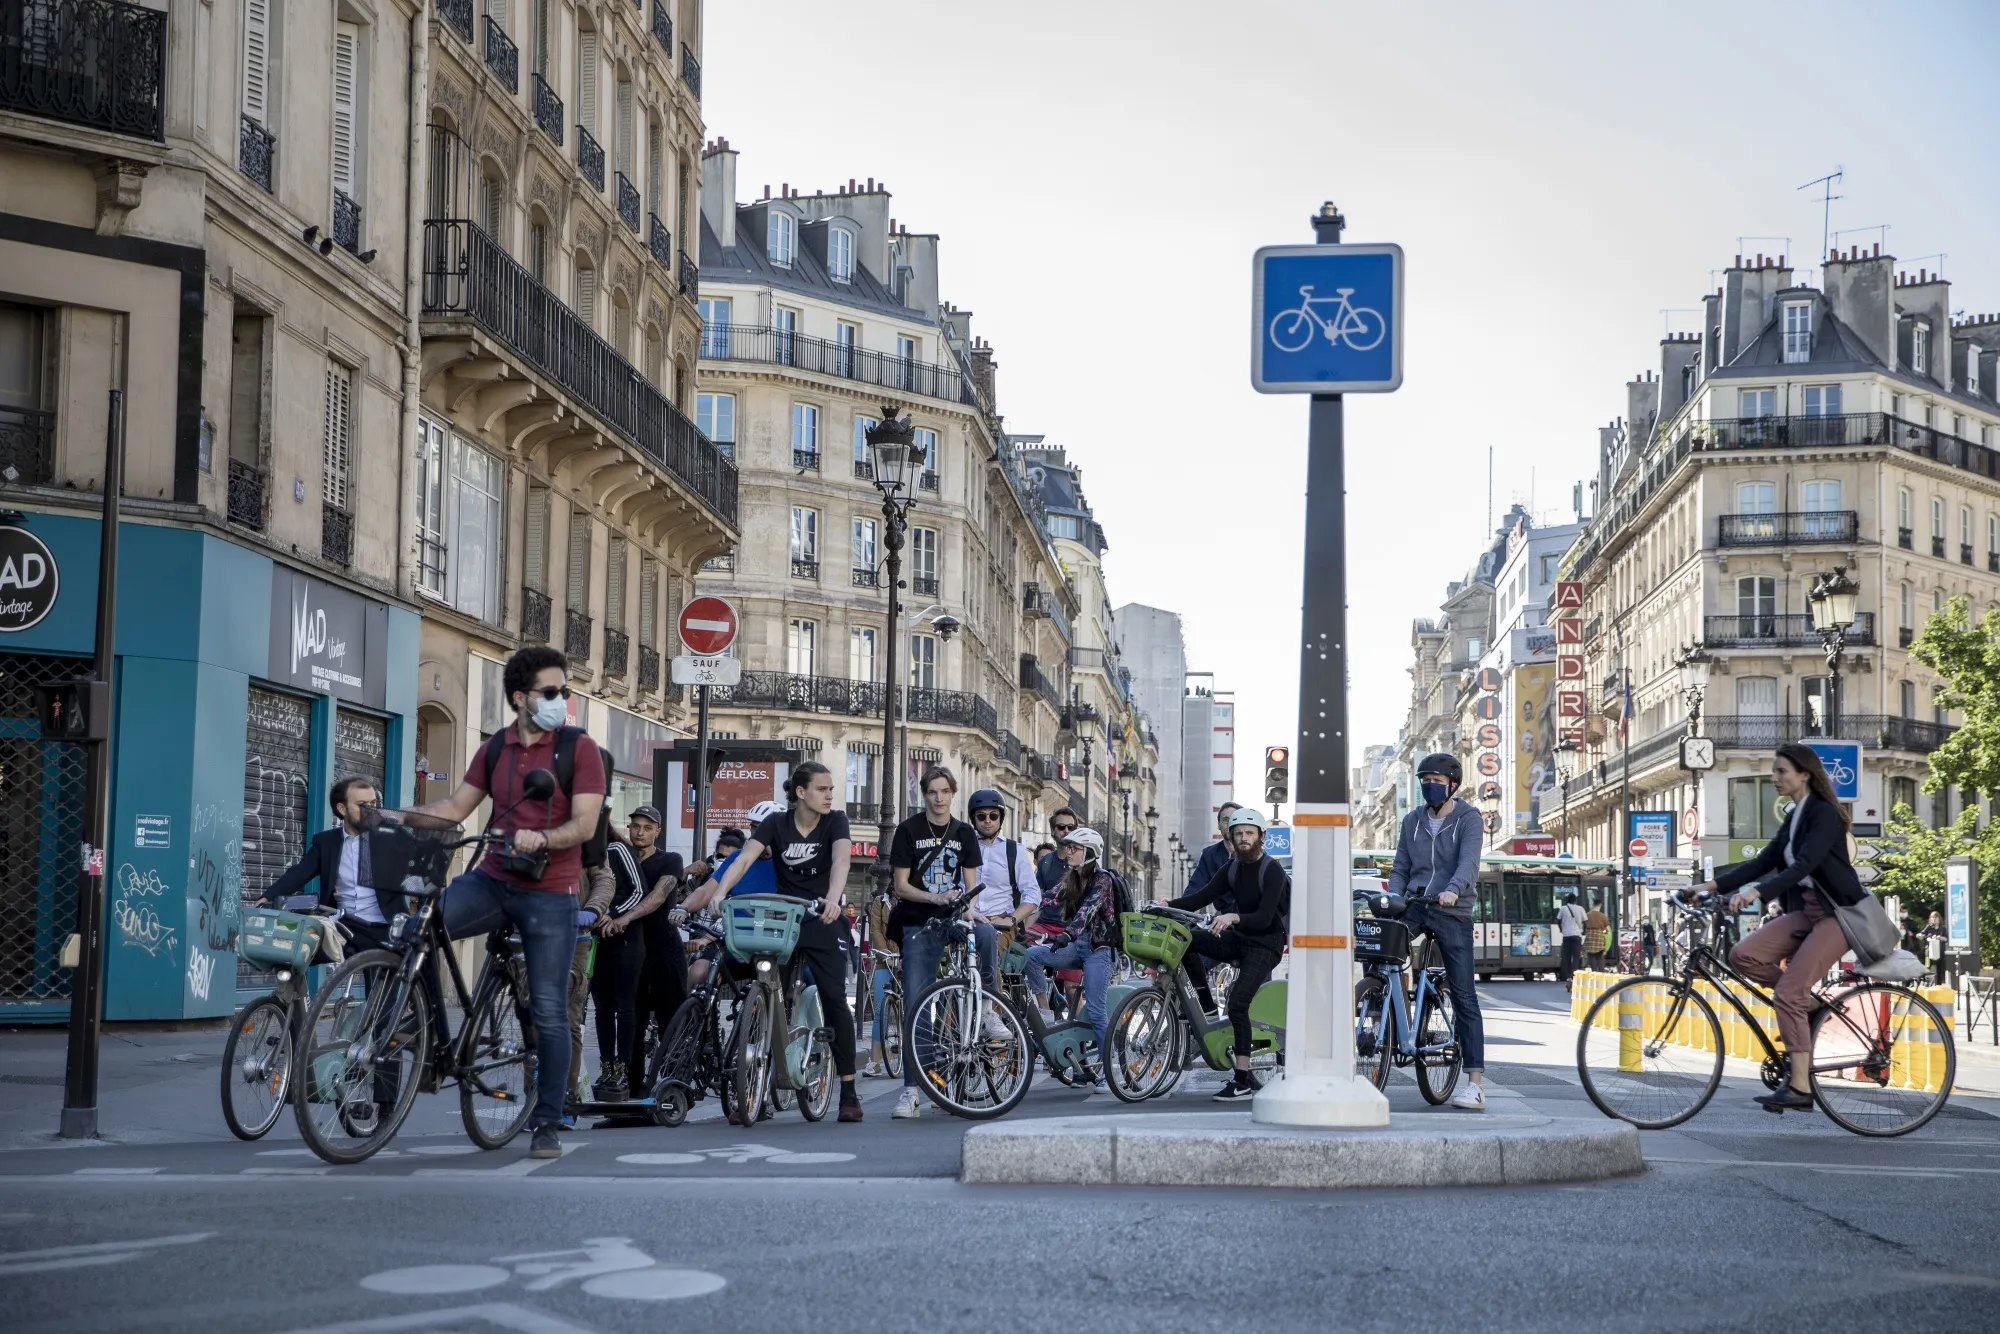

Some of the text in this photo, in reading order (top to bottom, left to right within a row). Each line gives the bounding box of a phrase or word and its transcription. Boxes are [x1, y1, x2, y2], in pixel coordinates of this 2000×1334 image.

[0, 553, 46, 590] AD
[0, 599, 33, 622] intage
[292, 580, 326, 675] MAD
[692, 659, 721, 668] SAUF
[786, 842, 817, 858] NIKE
[850, 841, 878, 856] ot Lo
[915, 838, 936, 849] FADING
[1526, 843, 1555, 853] Vos yeux
[1356, 923, 1381, 935] Véligo
